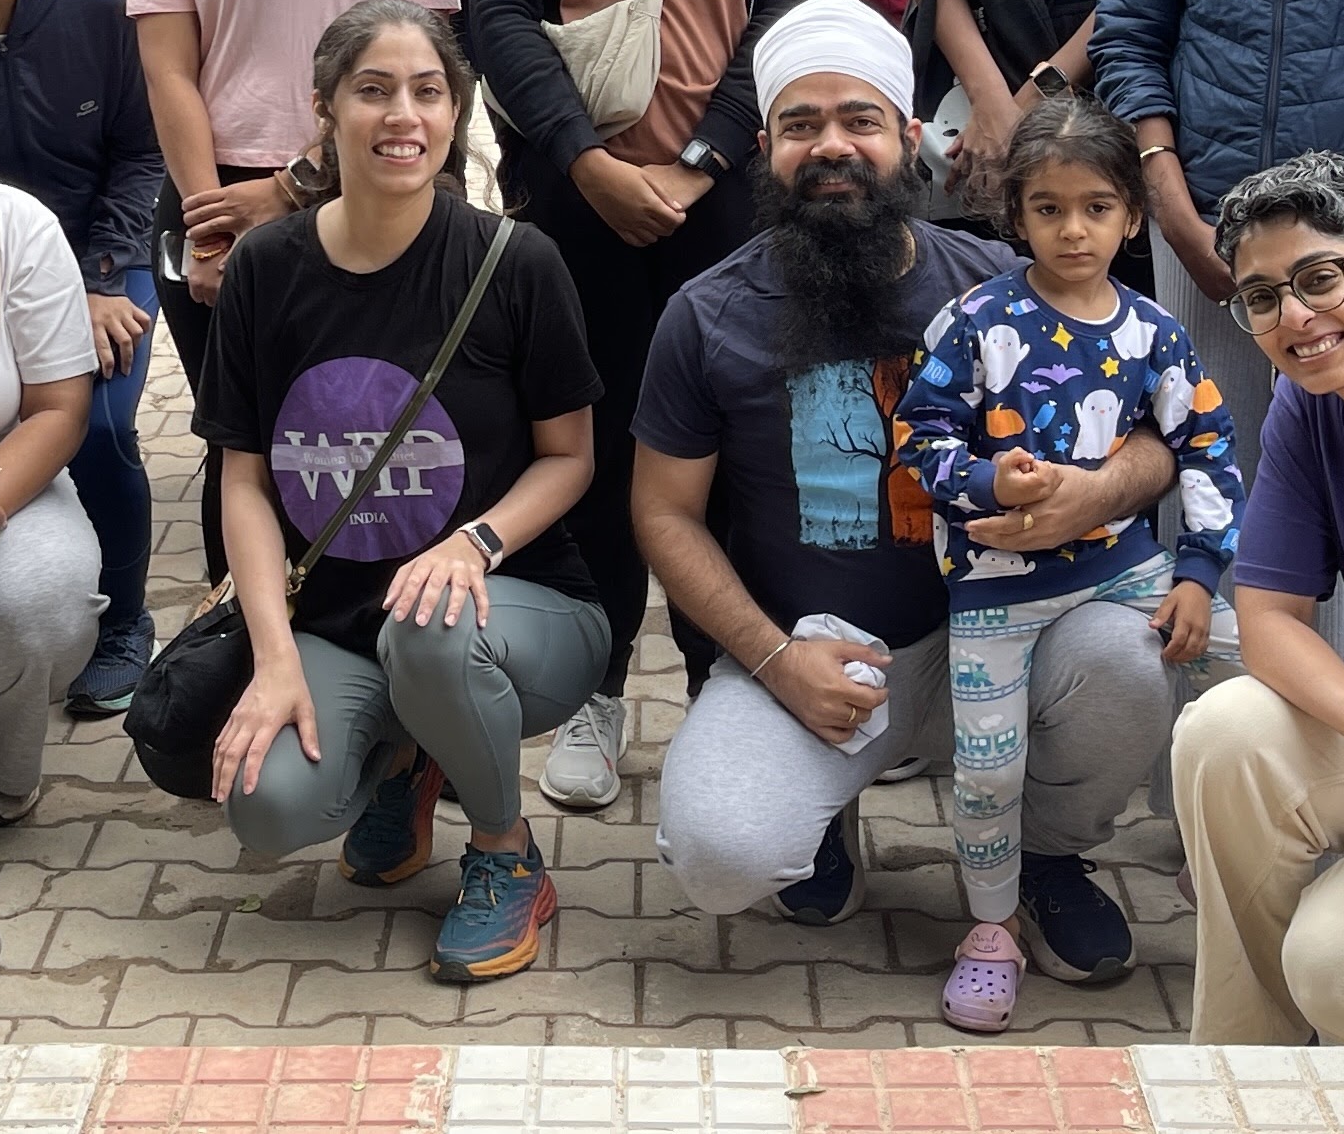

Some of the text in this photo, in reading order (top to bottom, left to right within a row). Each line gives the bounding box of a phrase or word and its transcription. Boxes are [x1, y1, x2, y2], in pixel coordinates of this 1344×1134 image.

[284, 429, 446, 501] WIP
[303, 451, 346, 465] Women
[367, 449, 417, 464] Pduct
[349, 512, 389, 526] INDIA
